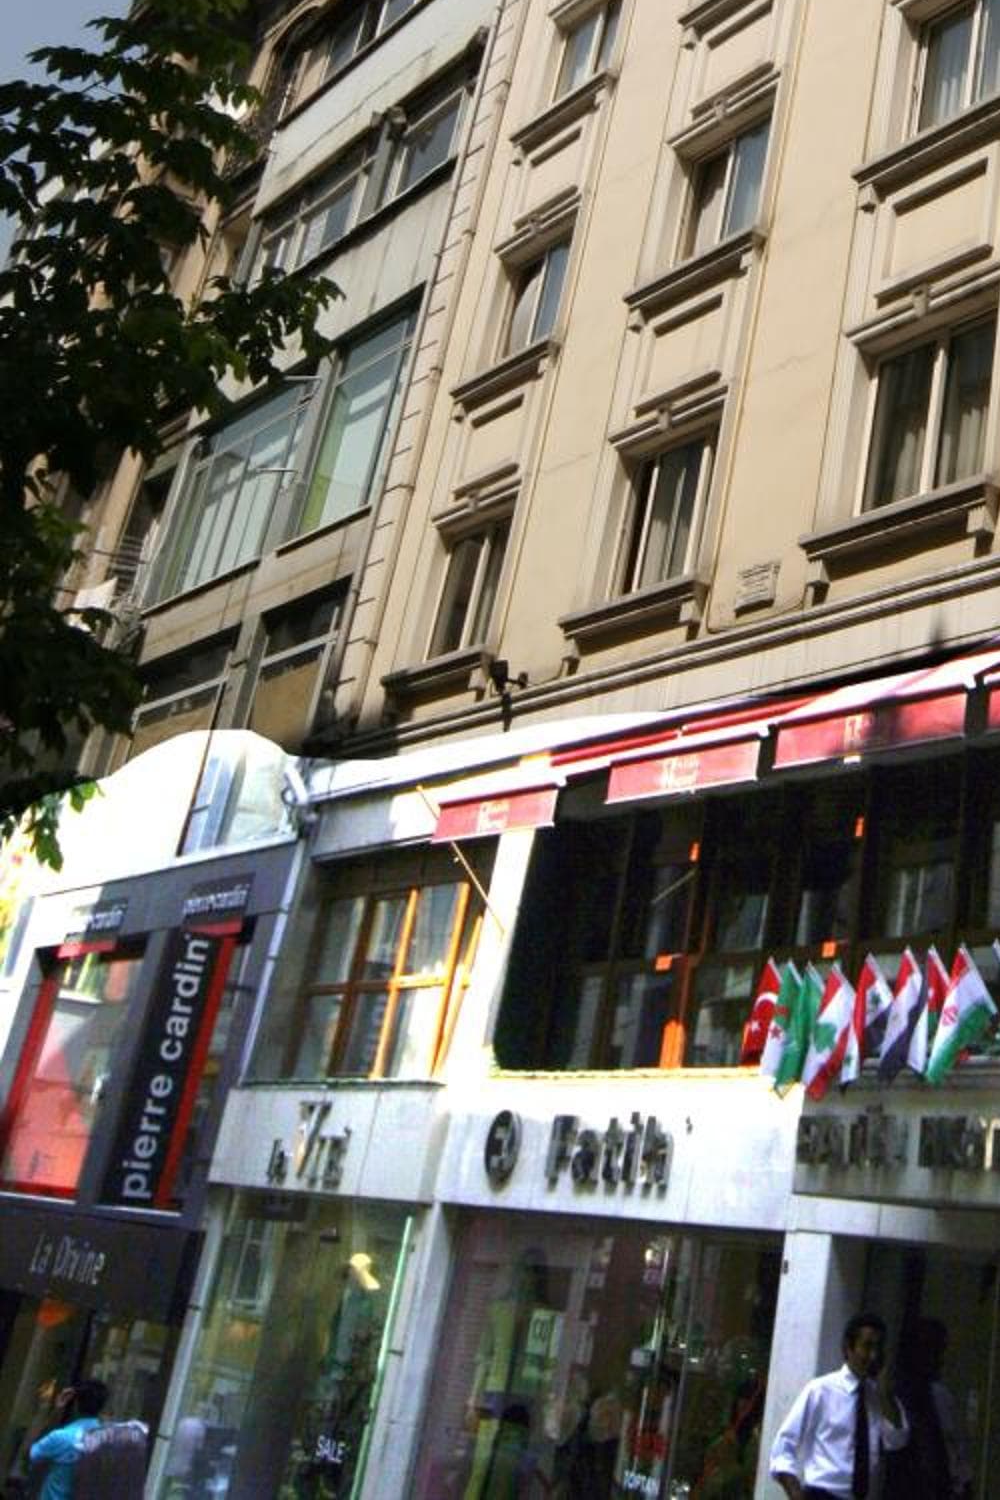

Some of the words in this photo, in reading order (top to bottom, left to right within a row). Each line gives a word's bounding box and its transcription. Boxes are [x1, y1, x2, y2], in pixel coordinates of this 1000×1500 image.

[122, 1075, 172, 1198] pierre
[160, 936, 209, 1061] cardin
[546, 1111, 674, 1198] Fatih
[316, 1435, 346, 1464] SALE
